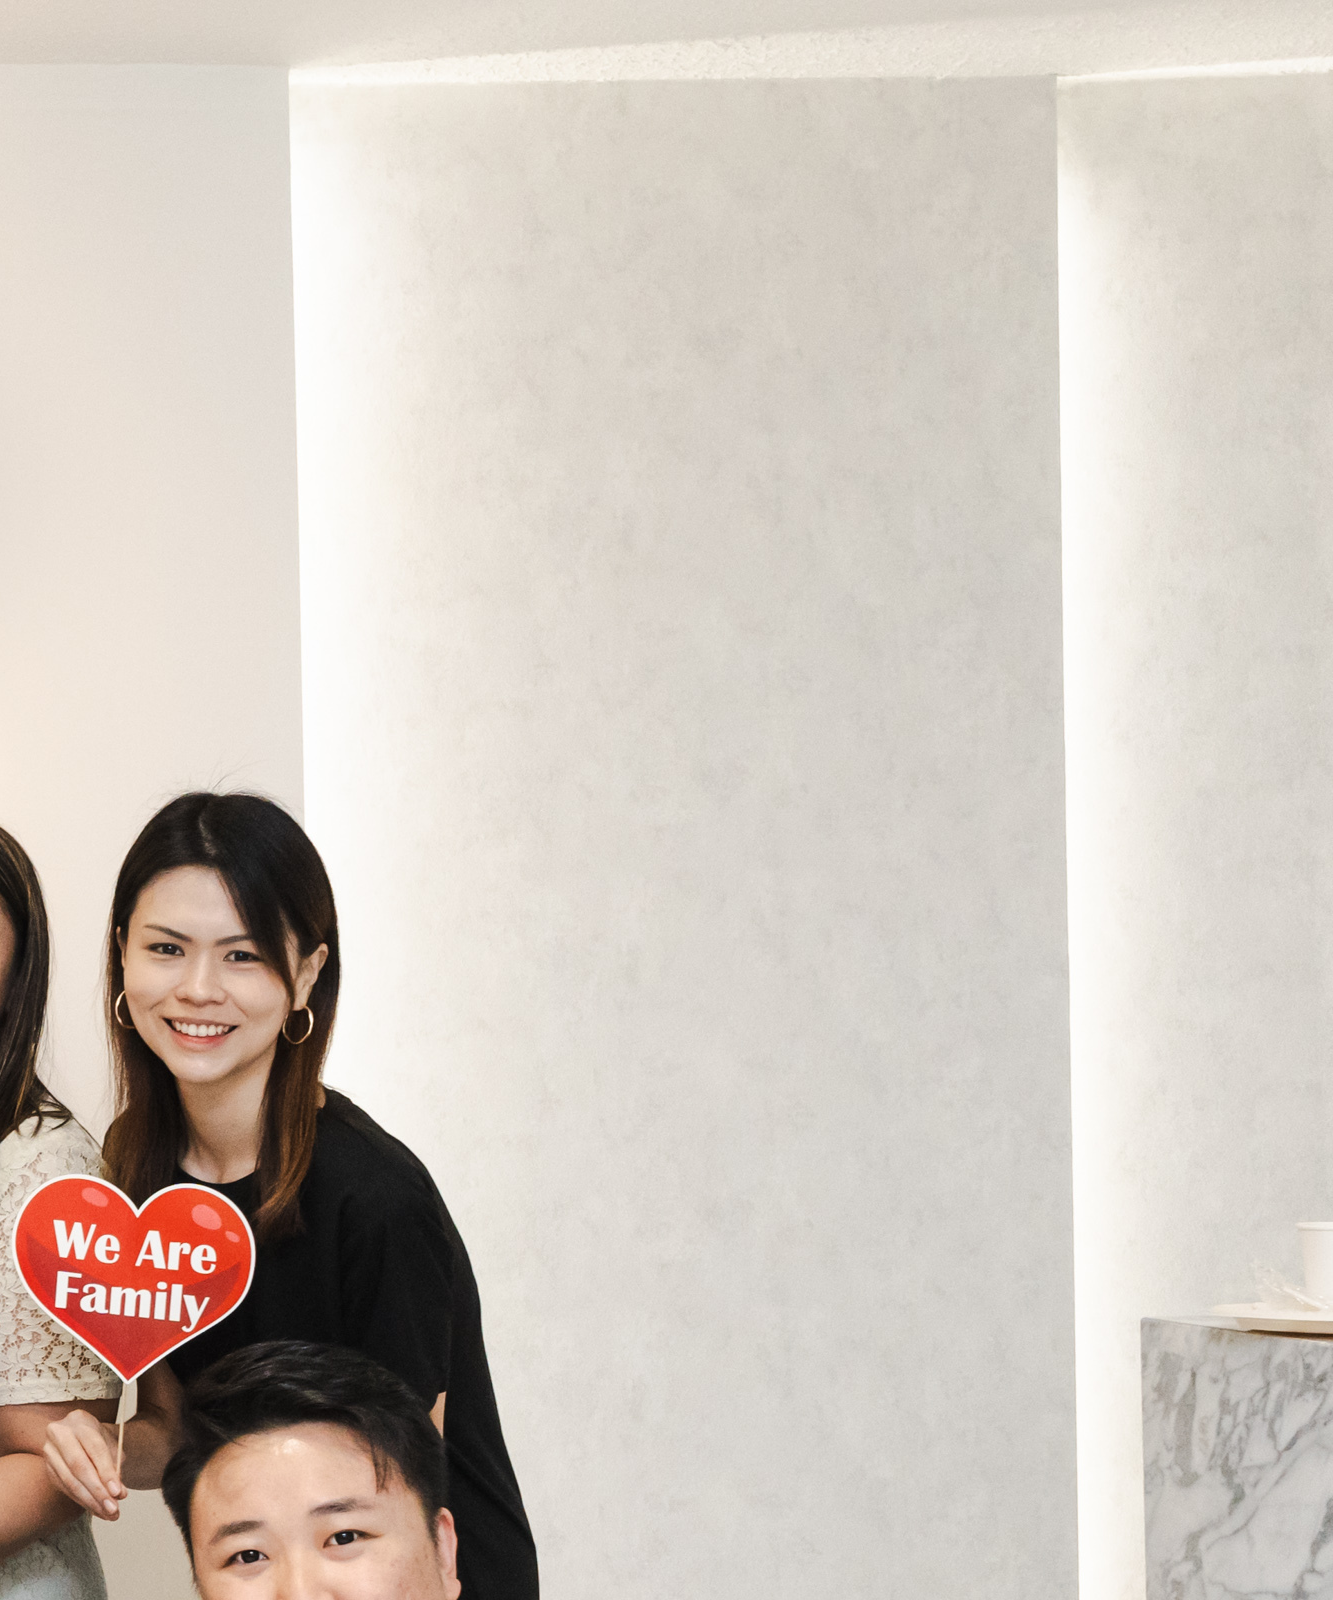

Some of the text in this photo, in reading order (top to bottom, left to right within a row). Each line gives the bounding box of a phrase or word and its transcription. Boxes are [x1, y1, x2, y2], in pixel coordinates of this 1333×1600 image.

[52, 1219, 218, 1275] We Are
[54, 1270, 211, 1333] Family
